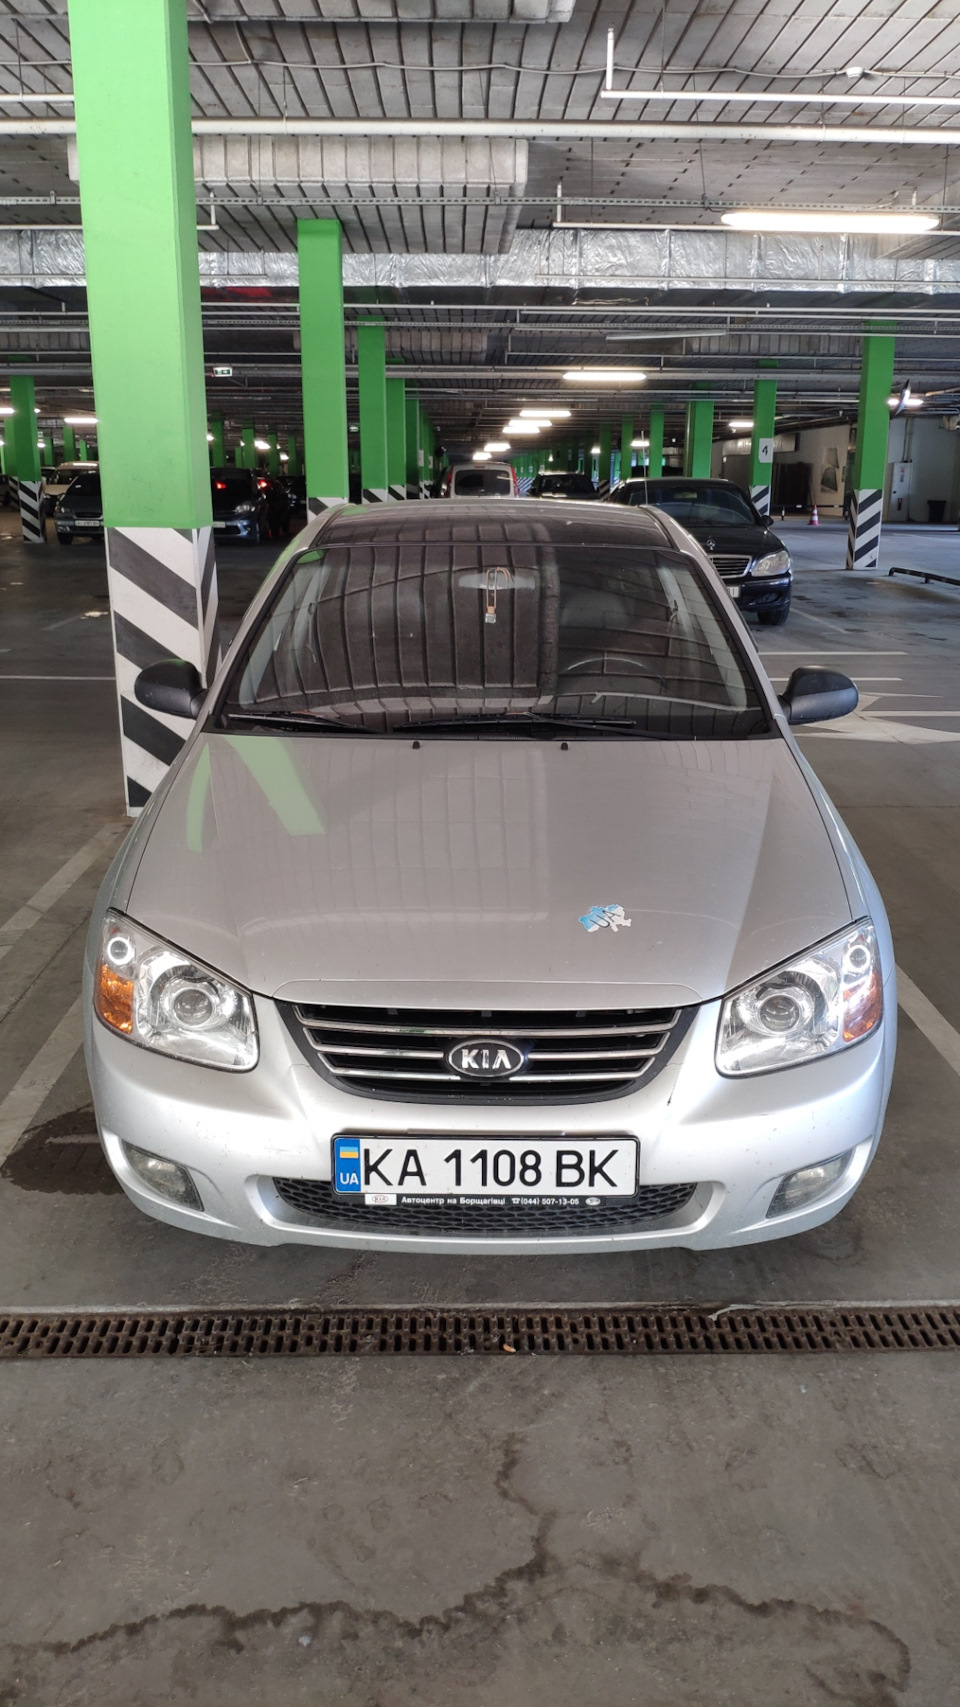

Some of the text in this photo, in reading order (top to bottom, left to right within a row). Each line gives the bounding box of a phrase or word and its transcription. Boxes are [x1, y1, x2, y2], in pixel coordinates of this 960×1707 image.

[762, 445, 769, 456] 4
[461, 1049, 512, 1069] KIA
[364, 1148, 619, 1188] KA 1108 BK
[340, 1172, 359, 1185] UA
[401, 1196, 445, 1206] Автоцентр
[460, 1196, 506, 1206] Борщагівці
[541, 1197, 580, 1206] 507-13-05
